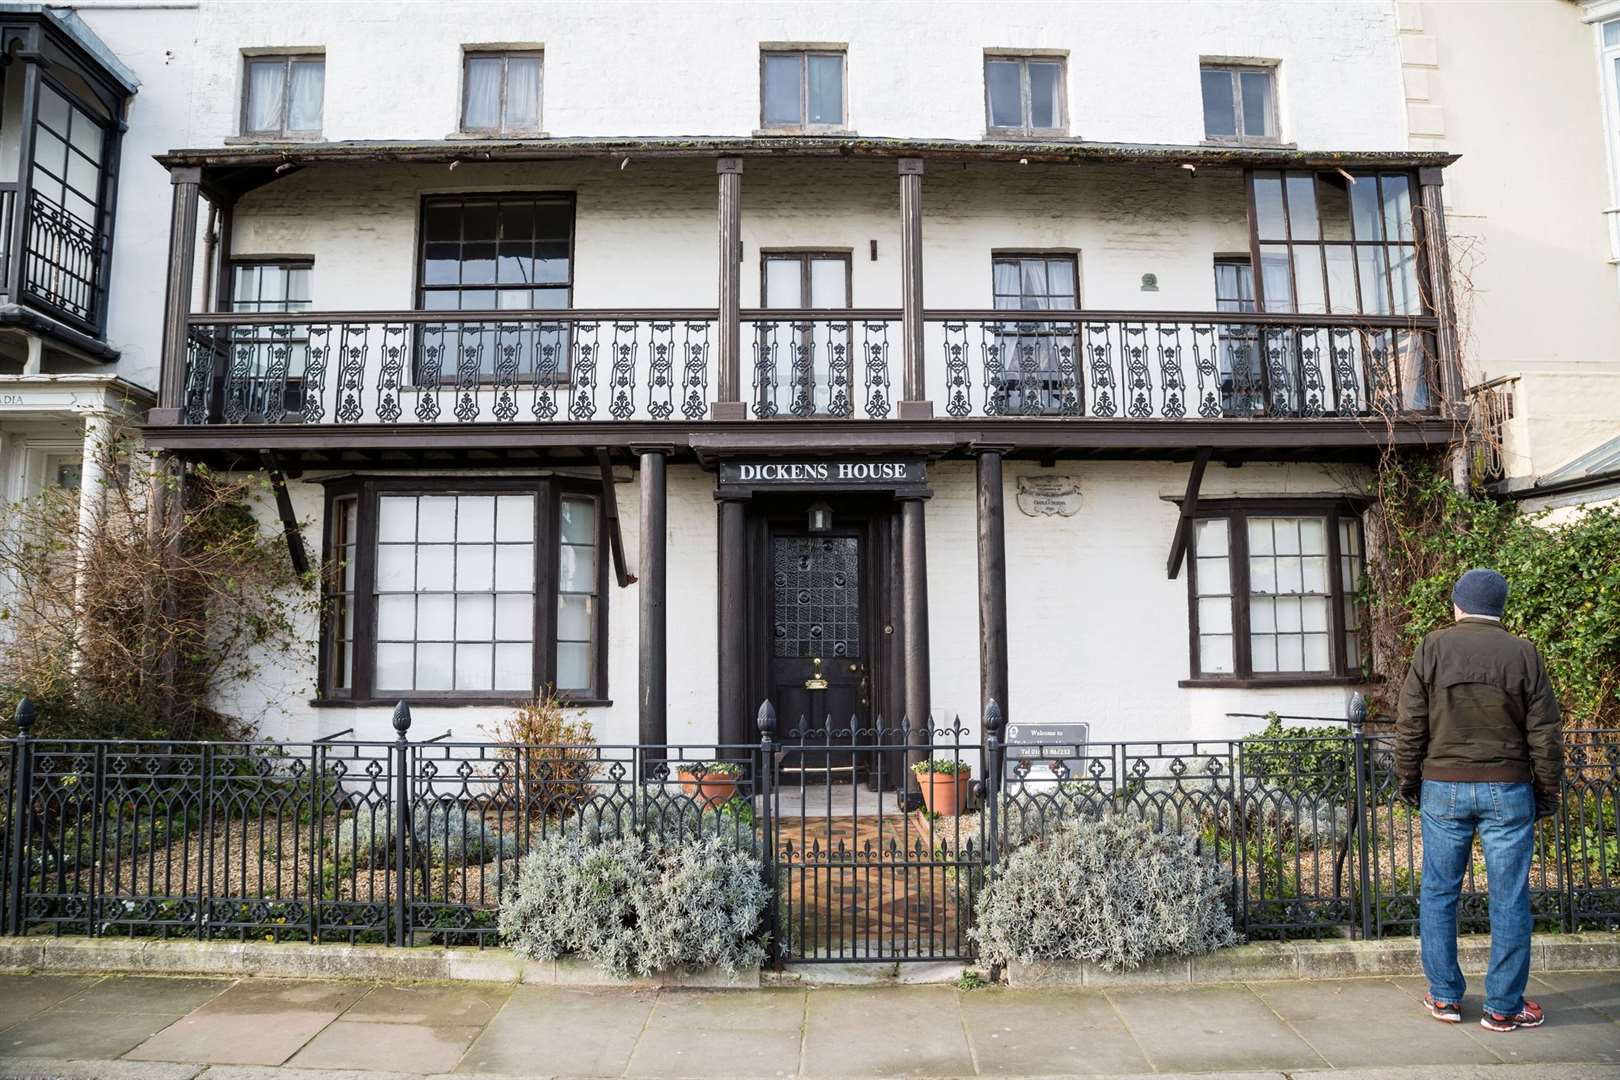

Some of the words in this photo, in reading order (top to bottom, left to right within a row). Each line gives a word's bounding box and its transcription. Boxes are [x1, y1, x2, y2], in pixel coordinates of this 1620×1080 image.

[0, 395, 23, 405] DIA
[740, 464, 828, 480] DICKENS
[838, 463, 907, 478] HOUSE
